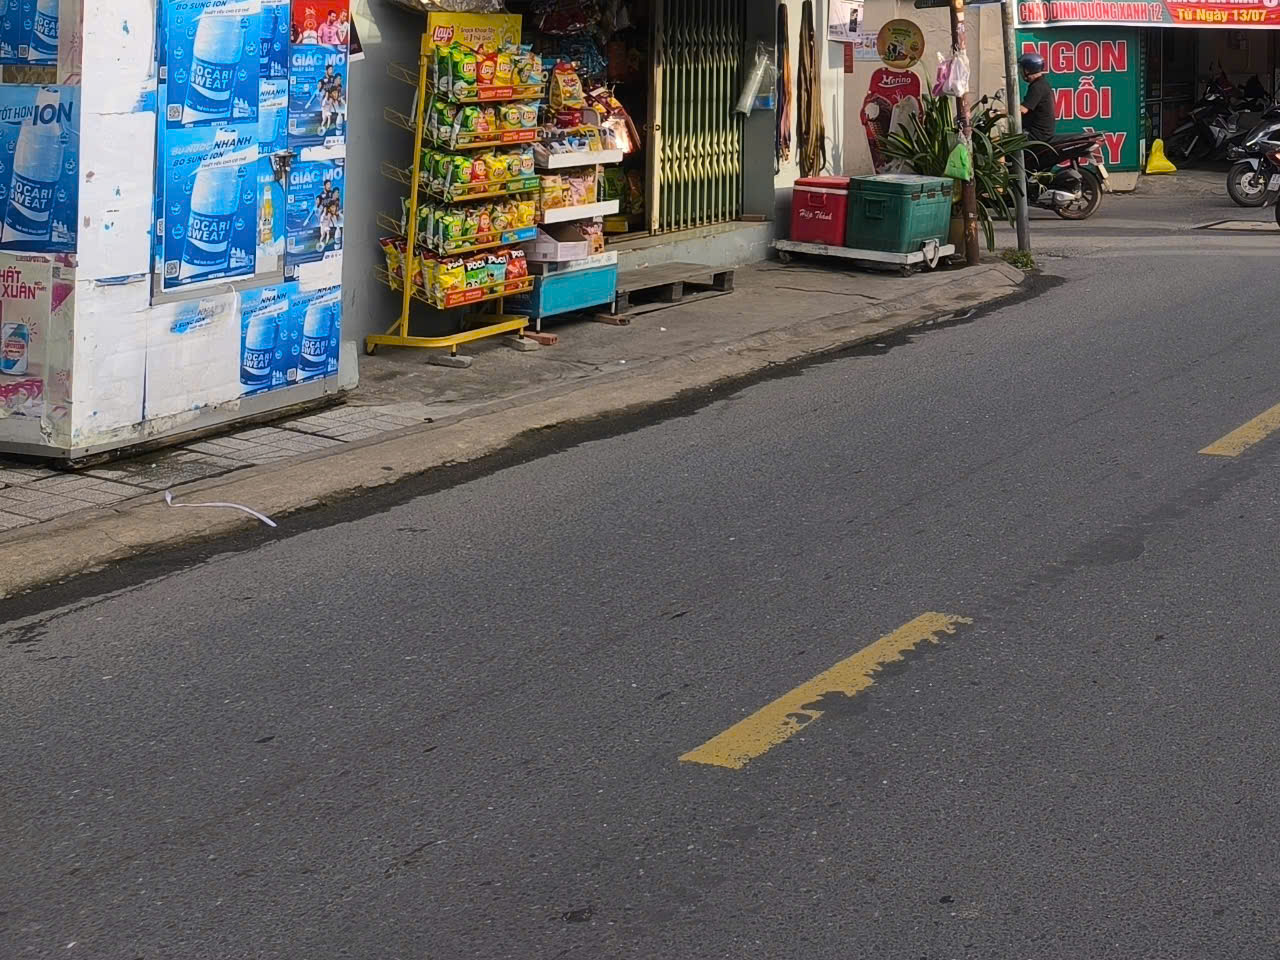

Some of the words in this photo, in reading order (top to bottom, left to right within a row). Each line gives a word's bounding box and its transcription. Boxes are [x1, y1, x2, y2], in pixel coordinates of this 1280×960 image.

[188, 1, 211, 10] SUNG
[212, 0, 227, 8] ION
[1050, 0, 1081, 22] DINH
[1118, 1, 1149, 22] XANH
[1196, 8, 1228, 24] Ngày
[1232, 9, 1267, 22] 13/07
[292, 49, 323, 67] GIẤC
[324, 51, 346, 67] MƠ
[190, 62, 233, 80] POCARI
[881, 73, 911, 86] Merino
[190, 73, 228, 89] SWEAT
[32, 101, 73, 126] ION
[213, 135, 252, 150] NHANH
[188, 154, 208, 165] SUNG
[209, 151, 225, 160] ION
[290, 165, 321, 186] GIẤC
[322, 166, 343, 181] MƠ
[11, 178, 53, 199] POCARI
[10, 190, 48, 209] SWEAT
[187, 218, 231, 232] POCARI
[186, 228, 226, 241] SWEAT
[466, 261, 486, 271] POCA
[1, 281, 37, 300] XUÂN
